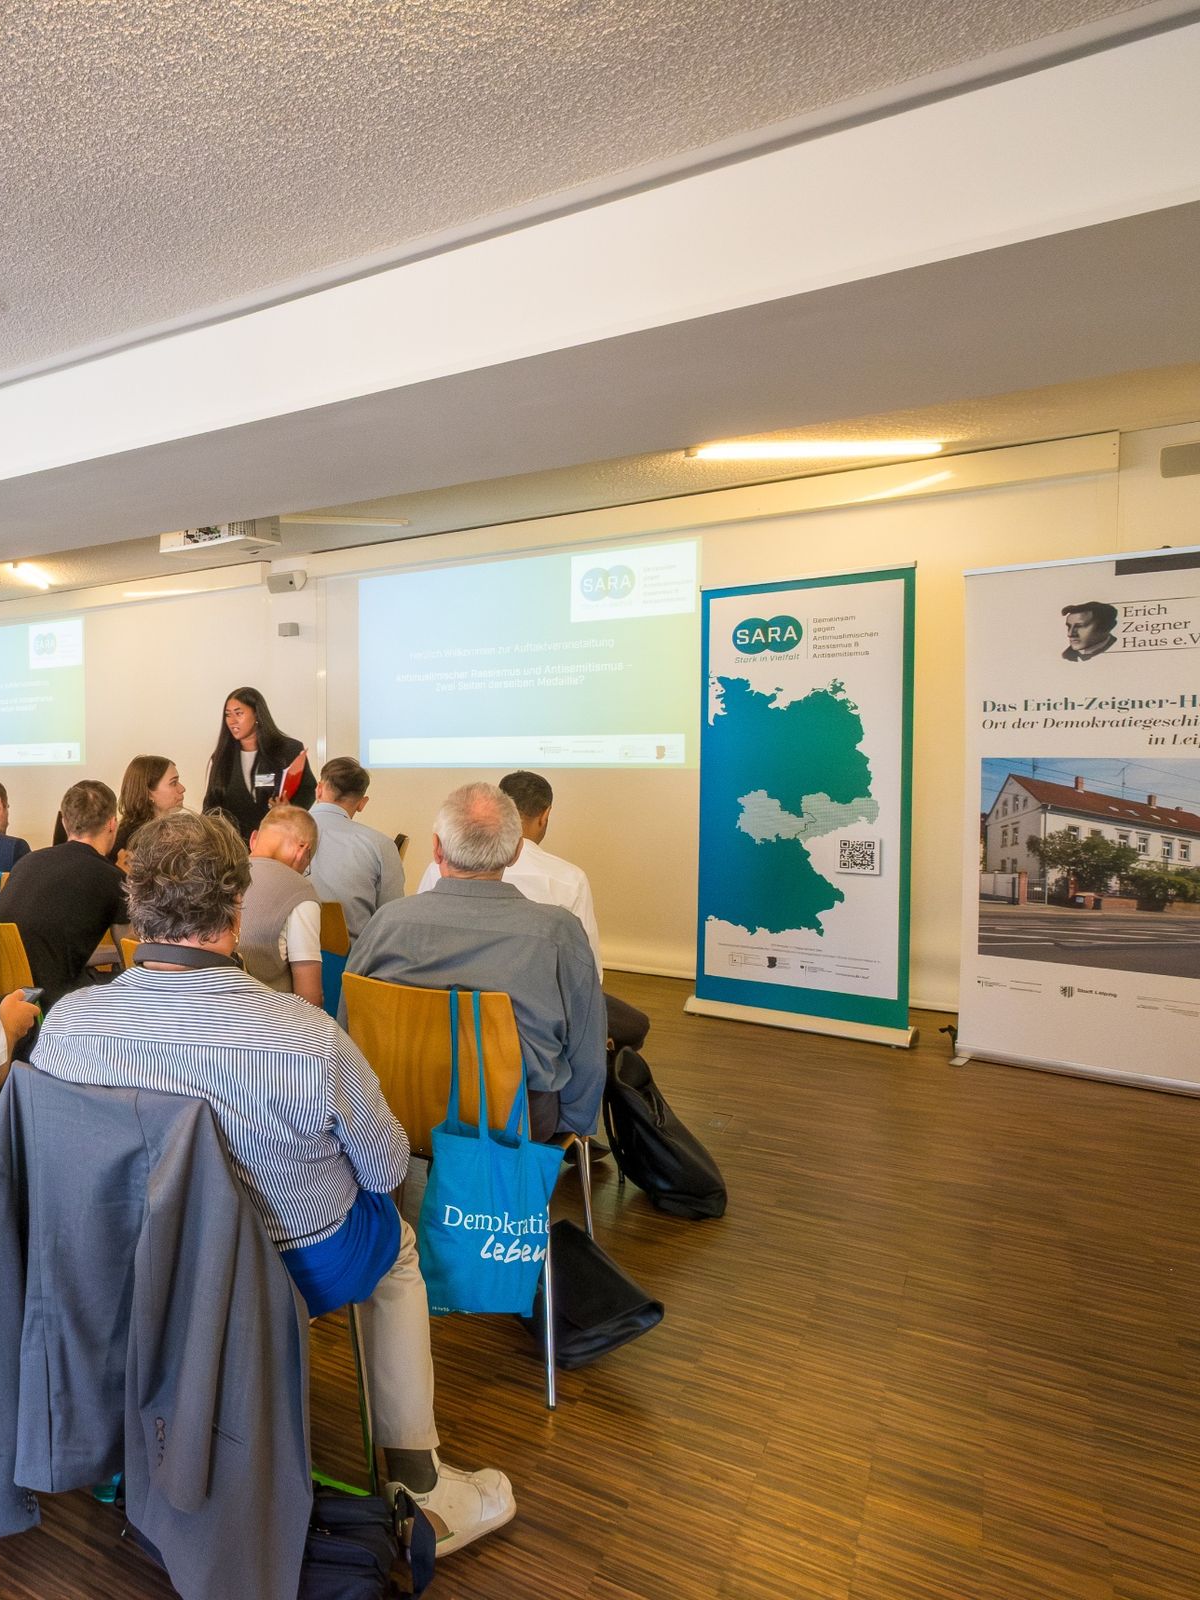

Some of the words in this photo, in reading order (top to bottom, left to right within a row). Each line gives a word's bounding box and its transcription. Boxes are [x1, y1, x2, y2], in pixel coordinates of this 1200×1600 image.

[583, 574, 632, 593] SARA
[1123, 604, 1167, 617] Erich
[812, 616, 856, 624] Gemeinsam
[1122, 620, 1191, 635] Zeigner
[736, 625, 798, 645] SARA
[812, 642, 852, 650] Rassismus
[1122, 636, 1168, 648] Haus
[735, 655, 757, 664] Stark
[760, 654, 767, 662] in
[770, 652, 800, 661] Vielfalt
[812, 650, 870, 659] Antisemitismus
[544, 661, 624, 675] Antisemitismus
[982, 700, 1017, 713] Das
[1023, 694, 1200, 714] Erich-Zeigner-H
[982, 718, 1007, 730] Ort
[1011, 717, 1039, 729] der
[1148, 733, 1165, 745] in
[1172, 733, 1200, 748] Lei
[480, 1233, 548, 1264] leben
